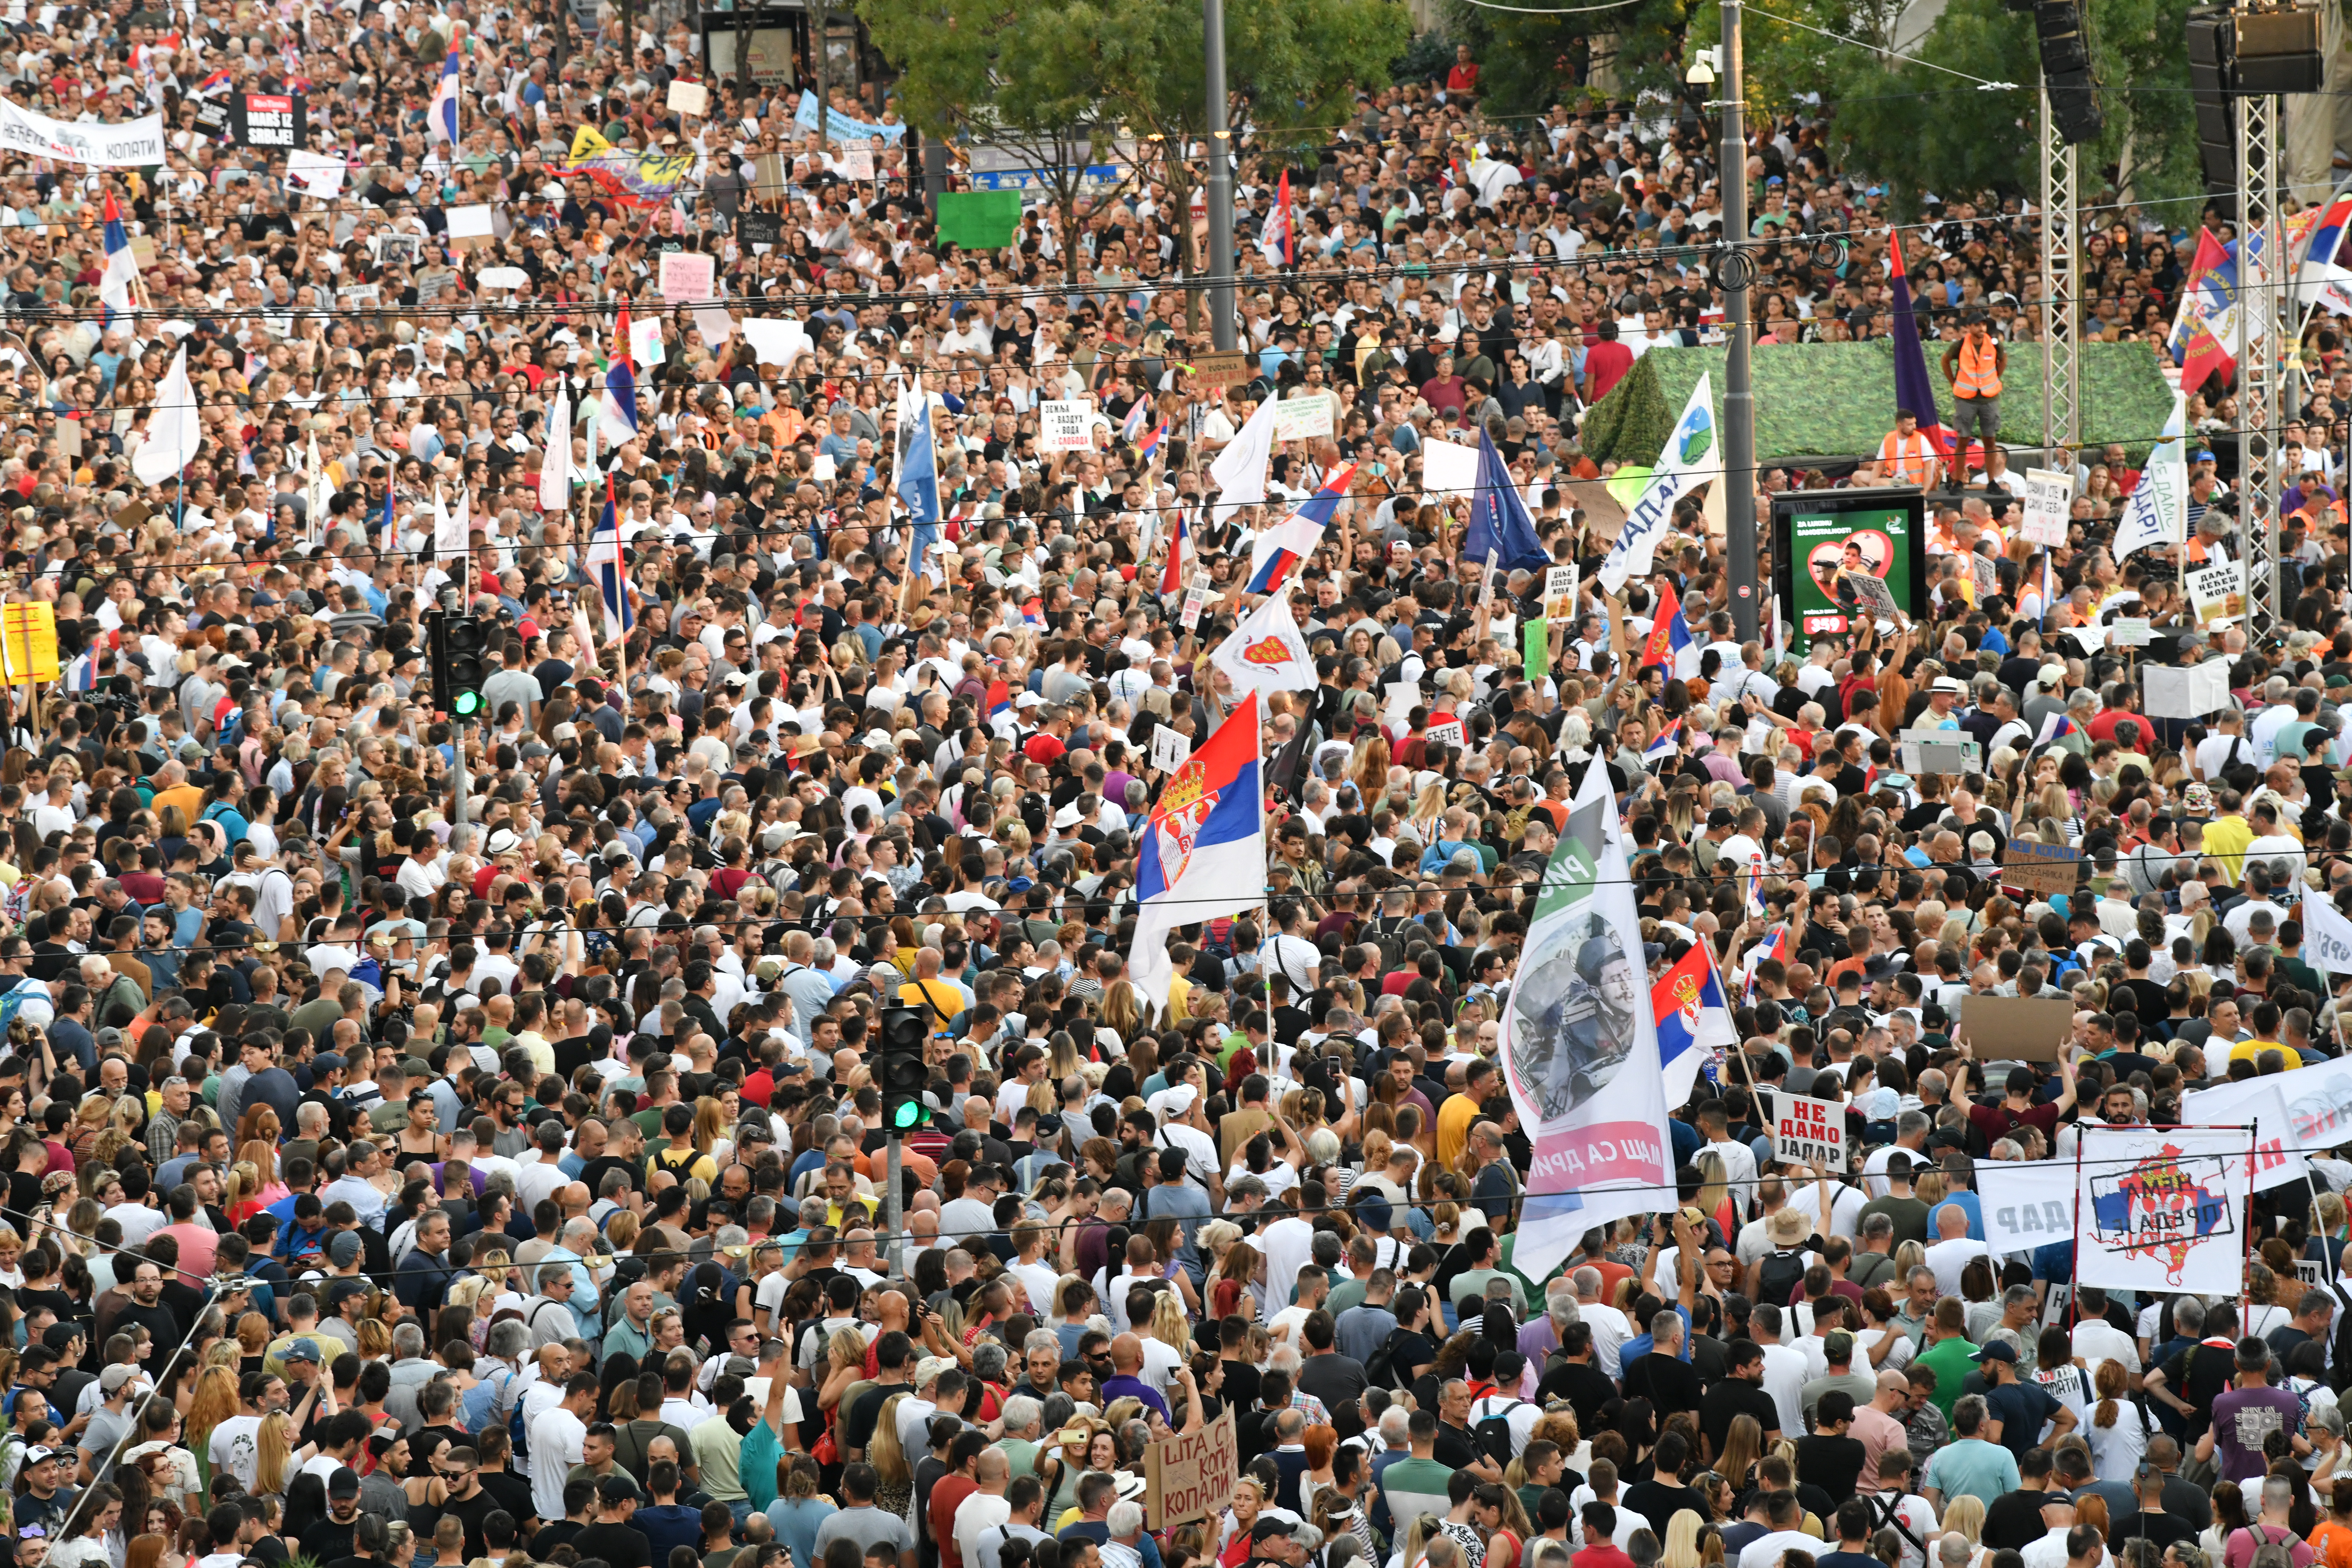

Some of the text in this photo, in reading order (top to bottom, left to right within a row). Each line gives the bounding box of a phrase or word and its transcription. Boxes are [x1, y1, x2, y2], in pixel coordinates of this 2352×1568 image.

[247, 109, 280, 127] MARŠ
[282, 113, 293, 128] IZ
[248, 127, 294, 145] SRBIJE!
[107, 139, 156, 160] КОПАТИ
[1057, 415, 1083, 424] ВАЗДУХ
[1062, 426, 1080, 435] ВОДА
[1058, 436, 1089, 446] СЛОБОДА
[1850, 575, 1886, 593] НЕЋЕТЕ
[2198, 575, 2239, 591] НЕЋЕШ
[2200, 568, 2232, 583] ДАЉЕ
[2205, 585, 2237, 598] МОЋИ
[1811, 617, 1840, 632] 359
[1427, 726, 1459, 742] ЕЋЕТЕ
[2036, 842, 2074, 862] КОПАТИ
[1793, 1100, 1826, 1123] НЕ
[1780, 1119, 1839, 1143] ДАМО
[1780, 1139, 1840, 1163] ЈАДАР
[1165, 1435, 1208, 1465] ШТА
